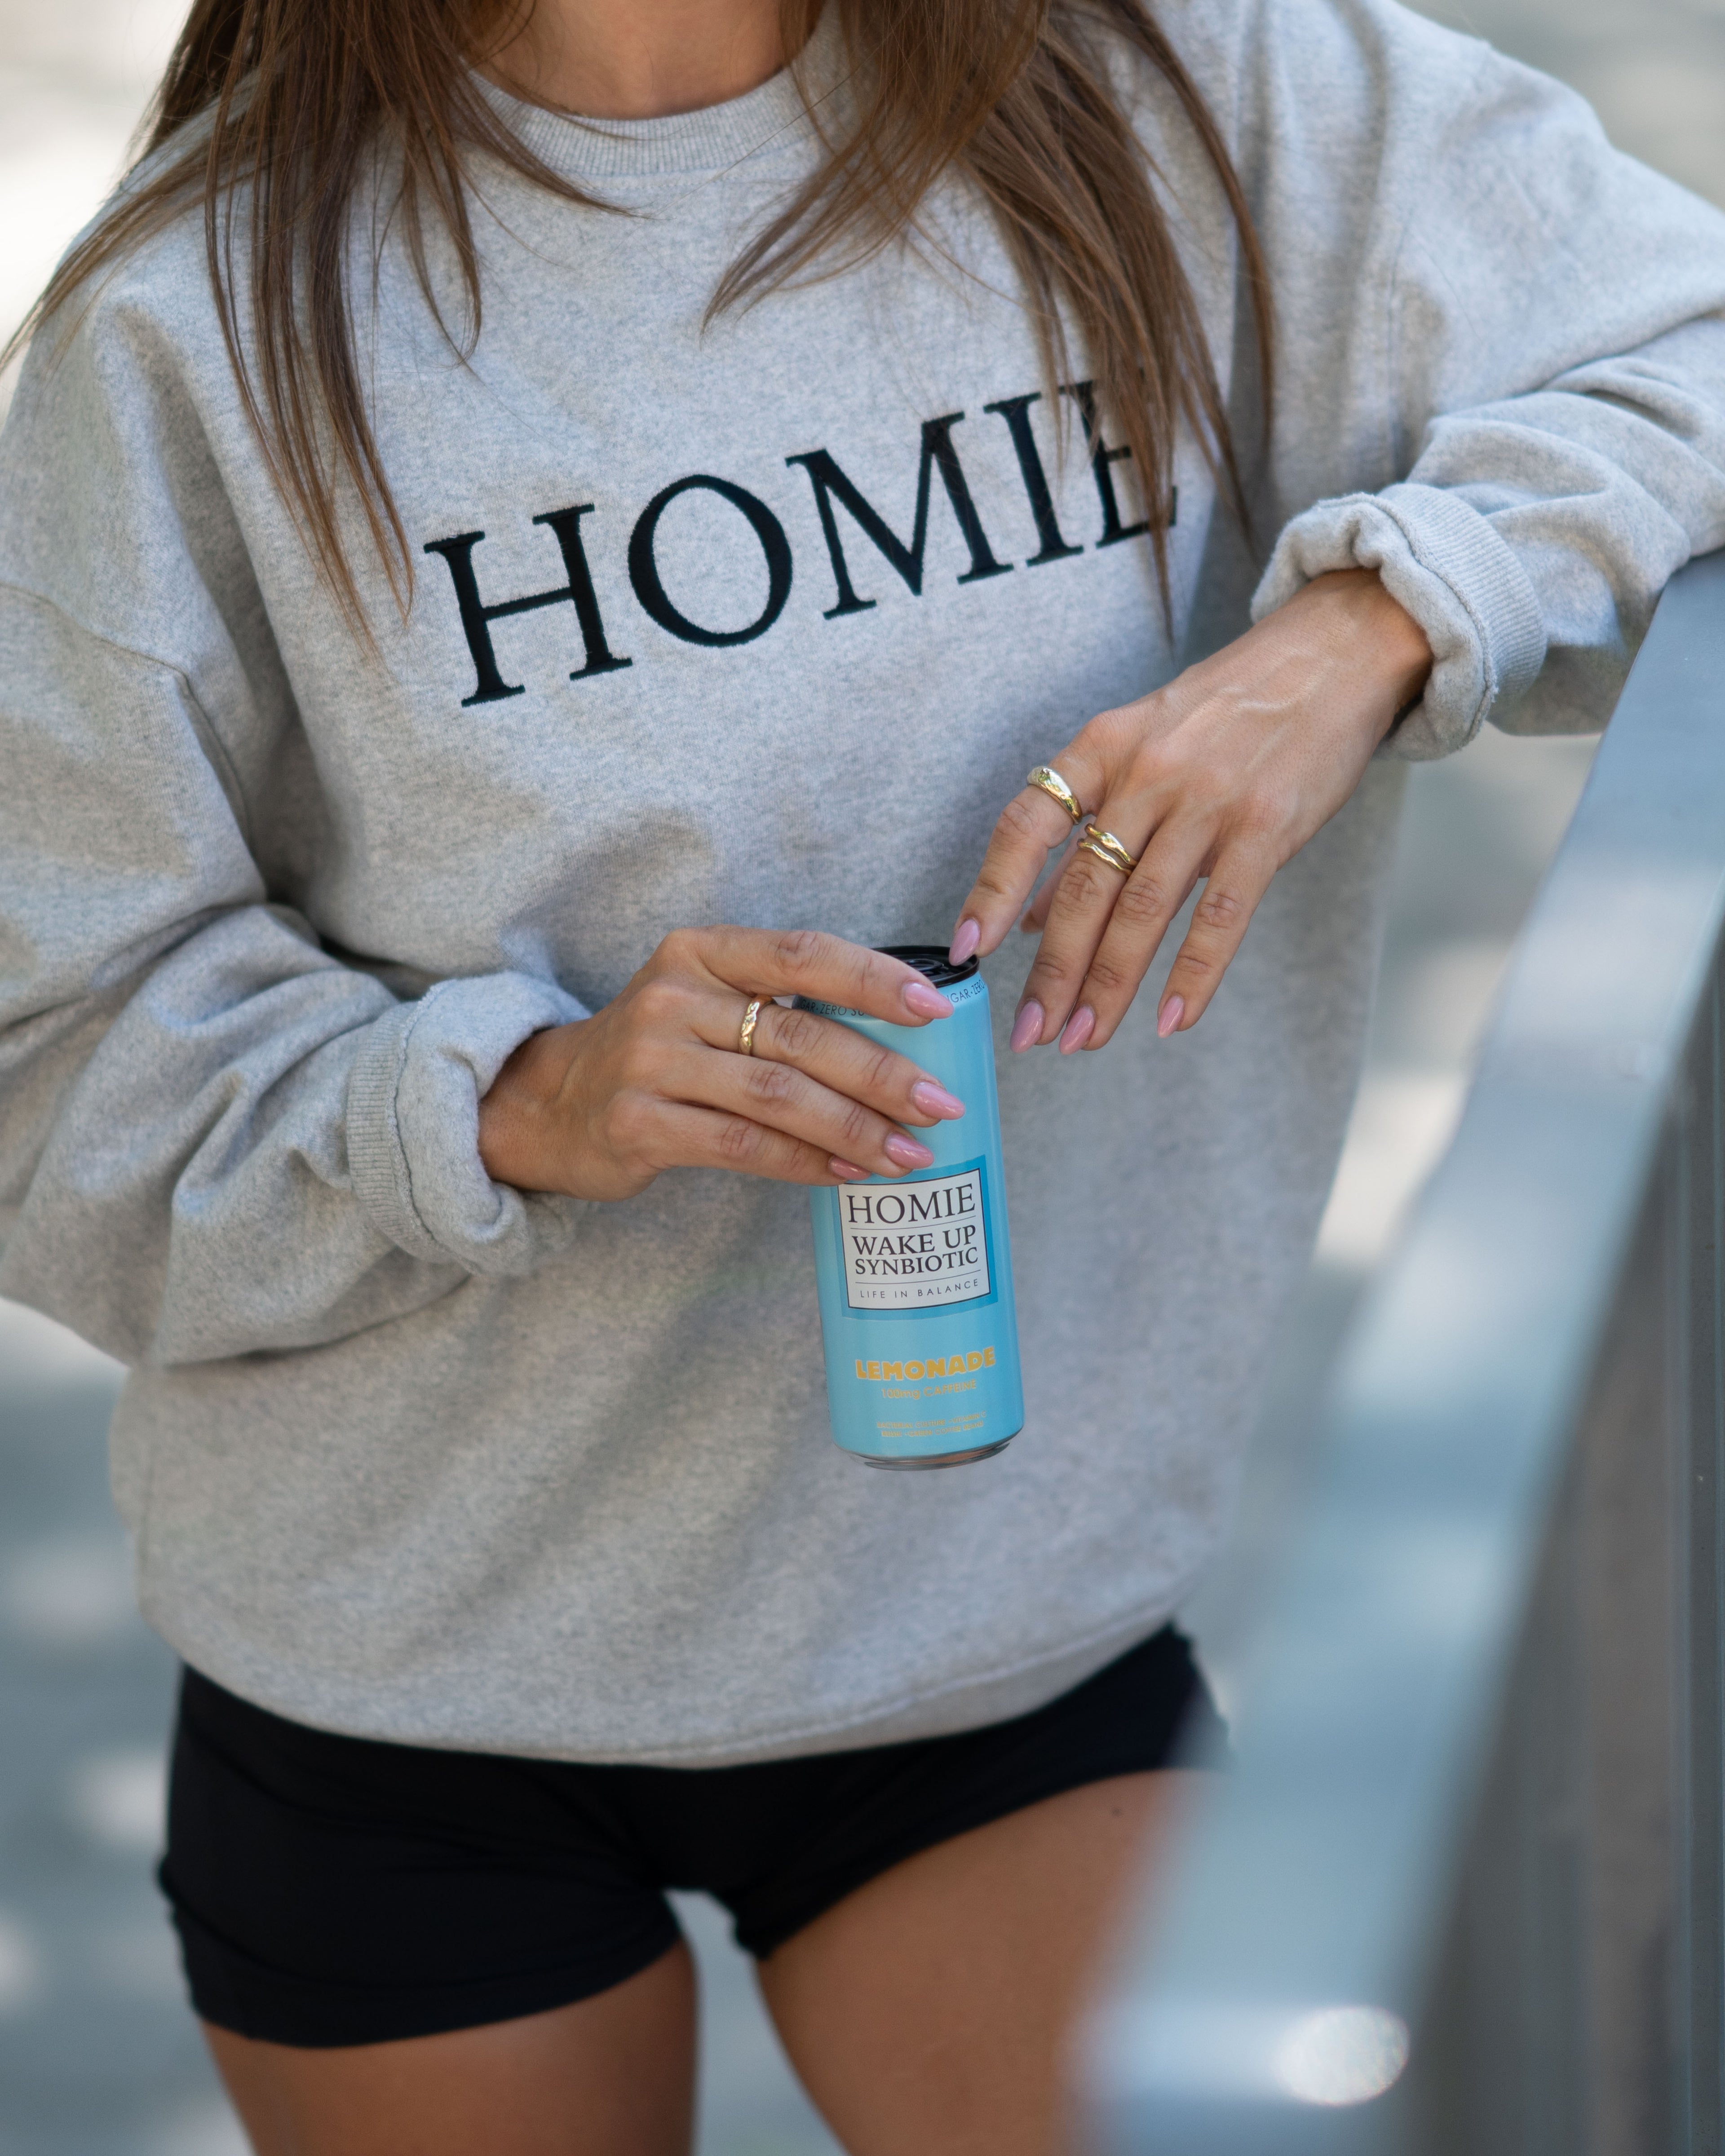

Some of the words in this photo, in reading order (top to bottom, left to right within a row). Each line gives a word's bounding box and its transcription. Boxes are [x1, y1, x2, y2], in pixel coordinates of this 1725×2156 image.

[424, 380, 1177, 706] HOMIE
[846, 1184, 976, 1224] HOMIE
[852, 1233, 935, 1255] WAKE
[942, 1225, 976, 1249] UP
[855, 1247, 978, 1275] SYNBIOTIC
[860, 1290, 886, 1299] LIFE
[918, 1279, 978, 1297] BALANCE
[855, 1346, 996, 1381] LEMONADE
[882, 1387, 920, 1400] 100mg
[924, 1379, 977, 1397] CAFFEINE
